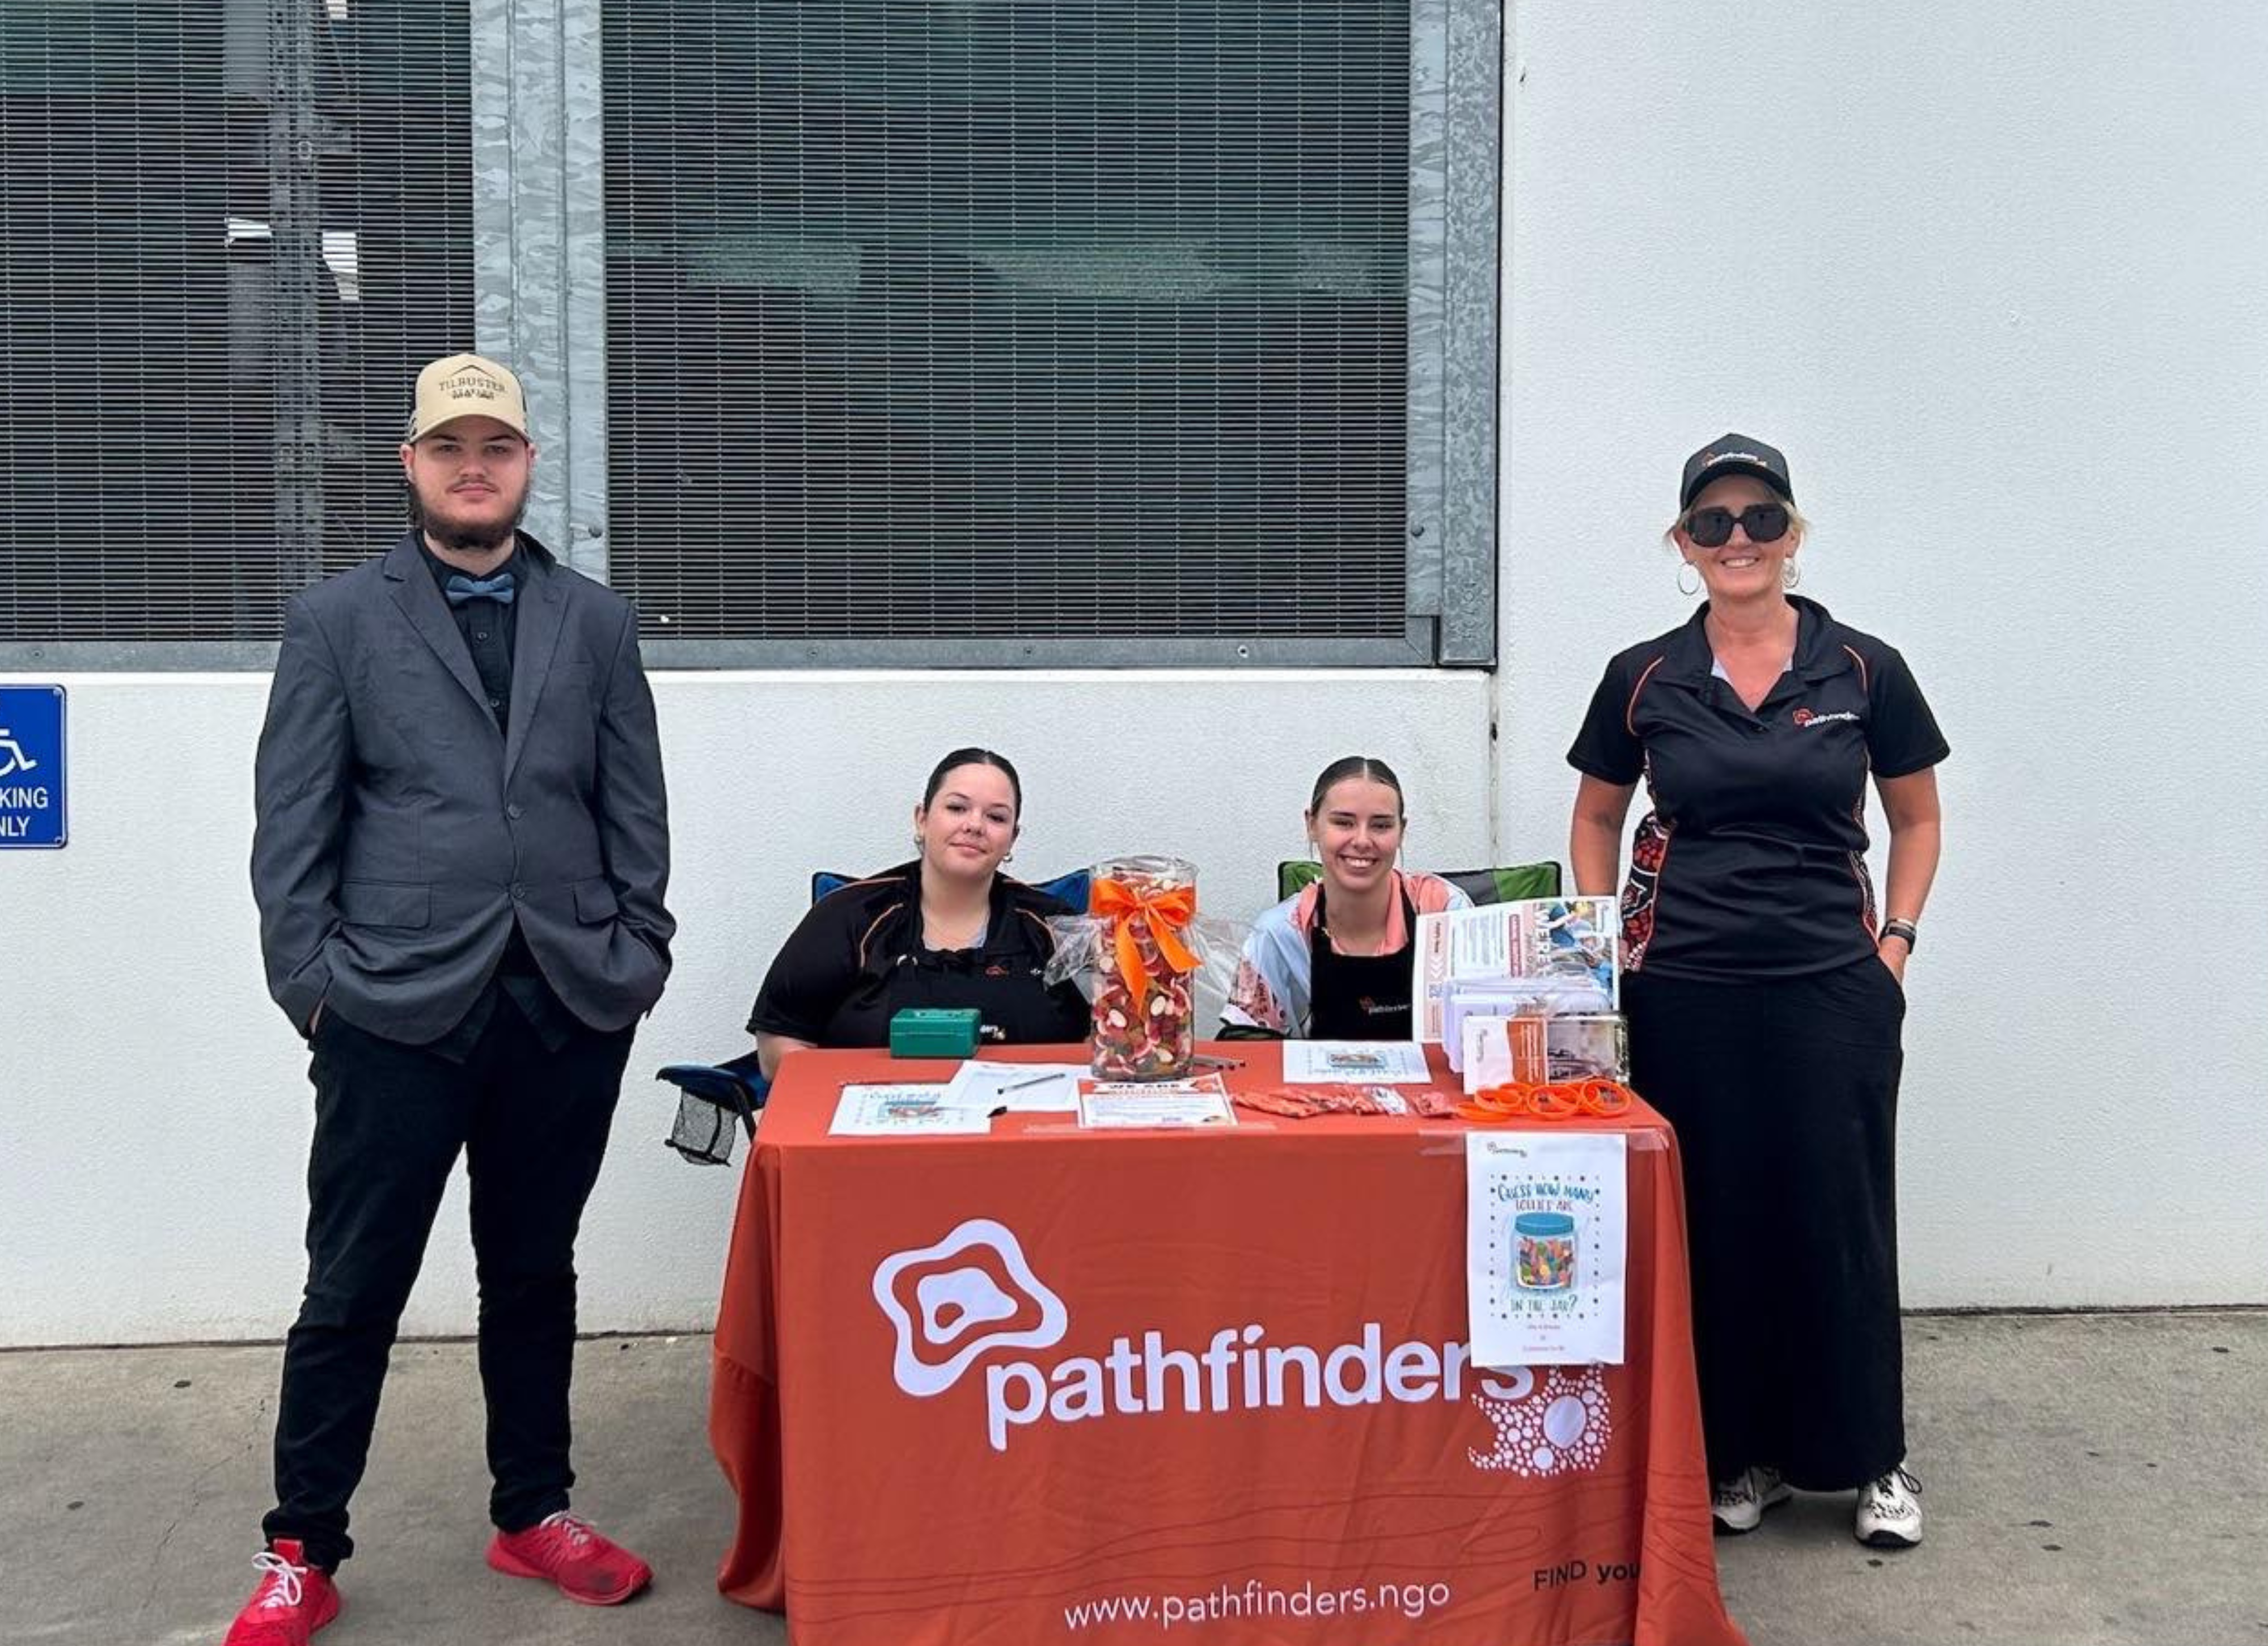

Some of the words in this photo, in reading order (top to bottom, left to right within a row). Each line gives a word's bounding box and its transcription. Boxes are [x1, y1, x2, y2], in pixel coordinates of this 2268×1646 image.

[986, 1323, 1534, 1452] pathfinders
[1534, 1561, 1586, 1591] FIND
[1064, 1579, 1449, 1630] www.pathfinders.ngo
